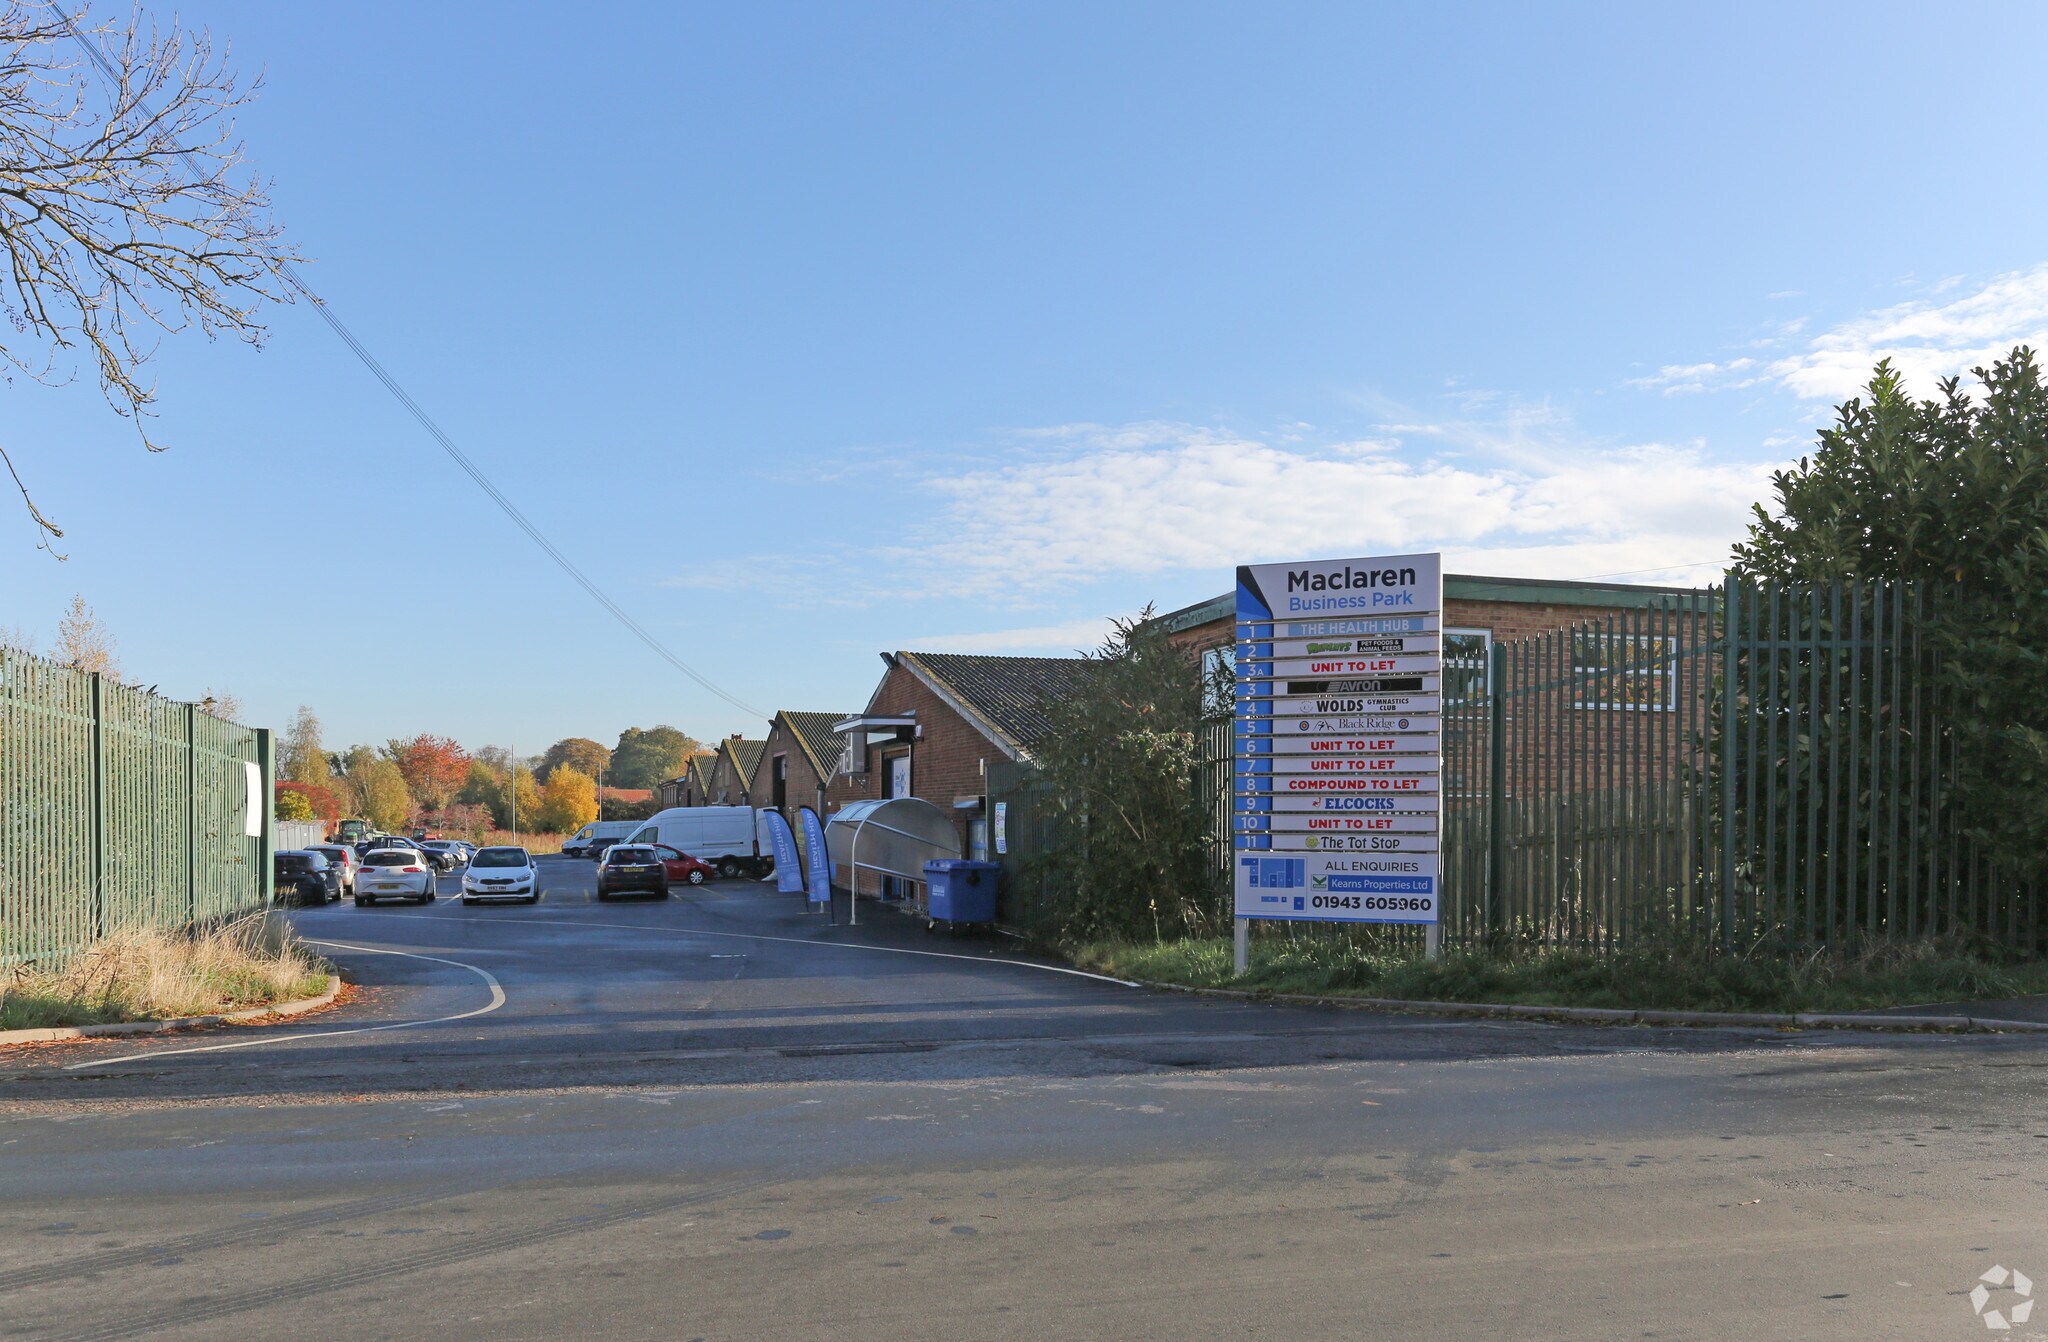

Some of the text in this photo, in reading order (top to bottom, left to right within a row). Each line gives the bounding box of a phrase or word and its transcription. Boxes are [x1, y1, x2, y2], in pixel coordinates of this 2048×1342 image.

[1288, 566, 1416, 592] Maclaren
[1289, 590, 1413, 611] Business Park
[1248, 625, 1255, 638] 1
[1301, 619, 1410, 635] THE HEALTH HUB
[1247, 645, 1256, 657] 2
[1247, 664, 1264, 676] 3A
[1311, 660, 1396, 672] UNIT TO LET
[1247, 683, 1256, 695] 3
[1247, 702, 1256, 714] 4
[1316, 699, 1363, 712] WOLDS
[1247, 721, 1256, 733] 5
[1339, 718, 1395, 730] Black Ridge
[1246, 740, 1256, 752] 6
[1310, 740, 1395, 750] UNIT TO LET
[1247, 759, 1256, 771] 7
[1311, 760, 1395, 770] UNIT TO LET
[1246, 778, 1256, 790] 8
[1289, 780, 1420, 790] COMPOUND TO LET
[1246, 797, 1256, 810] 9
[1324, 797, 1395, 809] ELCOCKS
[1241, 816, 1258, 829] 10
[1309, 819, 1393, 829] UNIT TO LET
[1245, 835, 1257, 847] 11
[1321, 836, 1400, 849] The Tot Stop
[1325, 861, 1419, 872] ALL ENQUIRIES
[1331, 878, 1428, 891] Kearns Properties Ltd
[1311, 896, 1432, 911] 01943 605960
